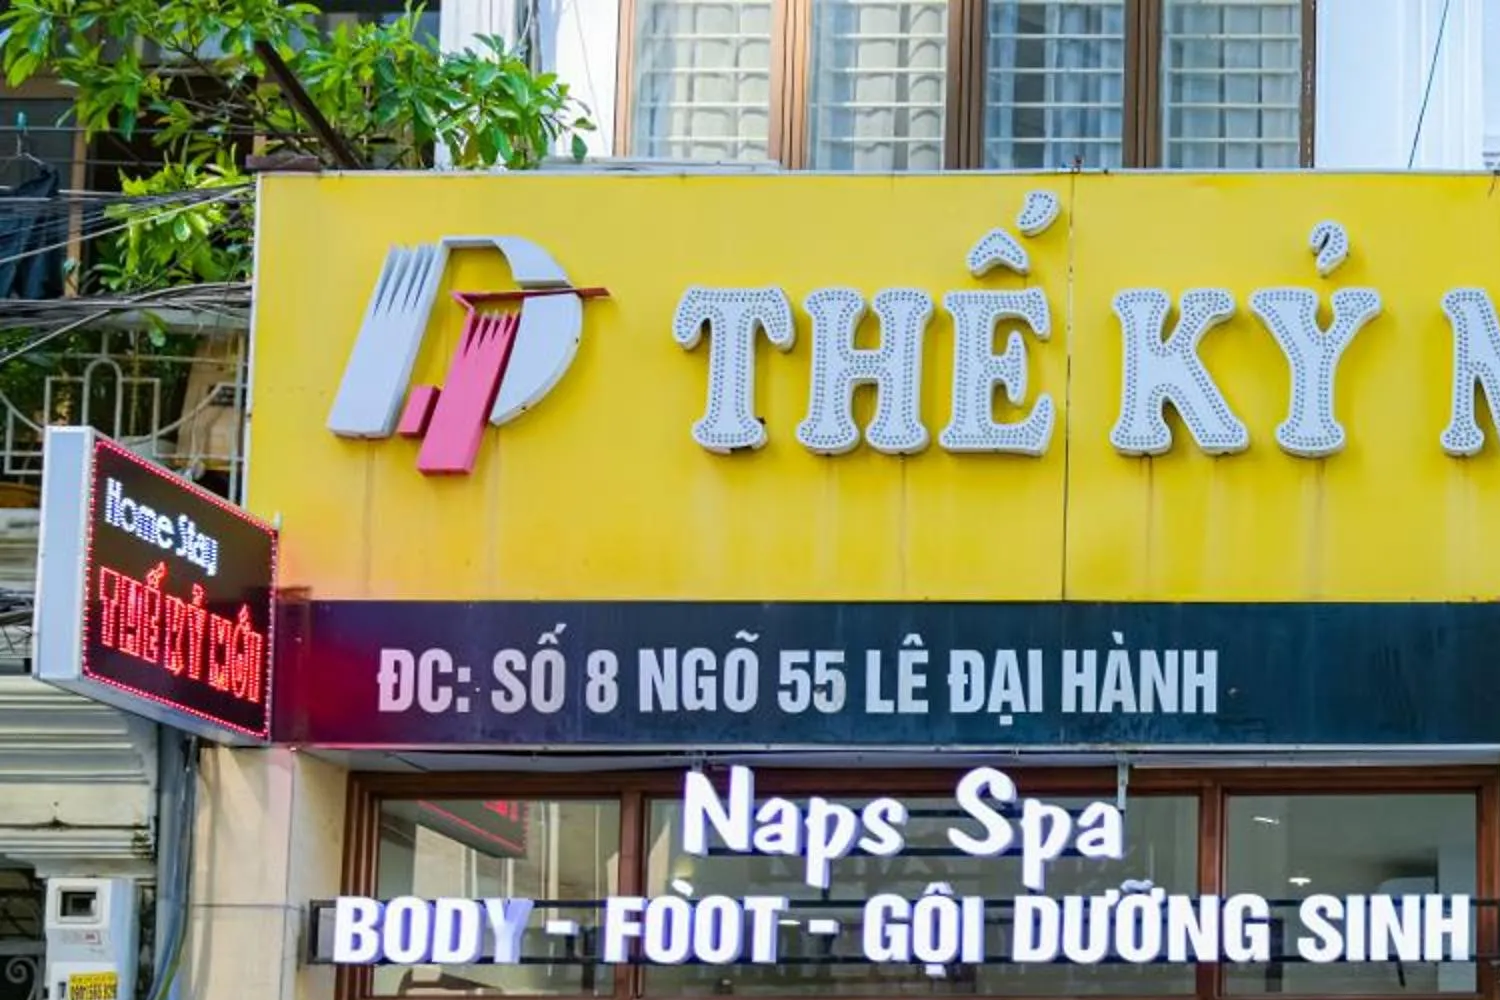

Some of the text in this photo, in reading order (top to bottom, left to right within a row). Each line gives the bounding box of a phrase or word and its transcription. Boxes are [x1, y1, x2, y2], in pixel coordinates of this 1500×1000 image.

[672, 190, 1060, 456] THẾ
[1109, 219, 1382, 458] KỶ
[105, 478, 173, 549] Home
[377, 623, 1217, 725] ĐC: SỐ 8 NGÕ 55 LÊ ĐẠI HÀNH
[682, 765, 1123, 890] Naps Spa
[332, 895, 534, 964] BODY
[862, 882, 984, 977] GỘI
[1012, 879, 1270, 962] DƯỠNG
[1298, 894, 1469, 962] SINH
